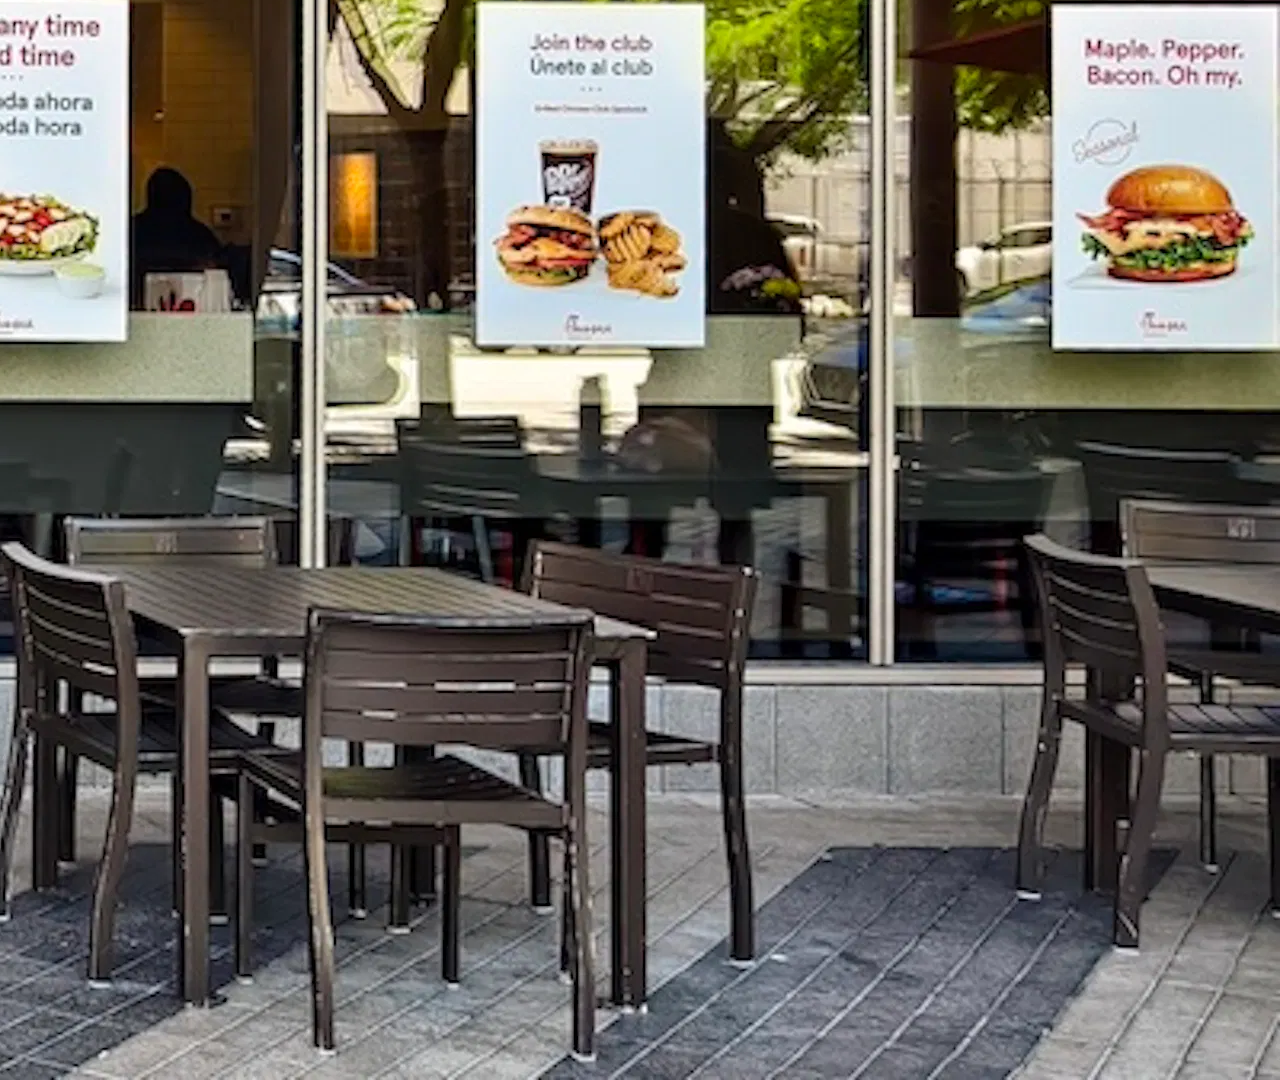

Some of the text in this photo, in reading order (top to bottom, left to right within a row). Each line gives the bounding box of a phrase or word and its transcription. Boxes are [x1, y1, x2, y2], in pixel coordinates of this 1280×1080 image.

[46, 14, 101, 37] time
[530, 33, 654, 51] Join the club
[1084, 38, 1246, 64] Maple. Pepper.
[20, 44, 75, 67] time
[530, 52, 654, 76] Únete al club
[1087, 64, 1244, 90] Bacon. Oh my.
[34, 91, 94, 112] ahora
[35, 117, 83, 137] hora
